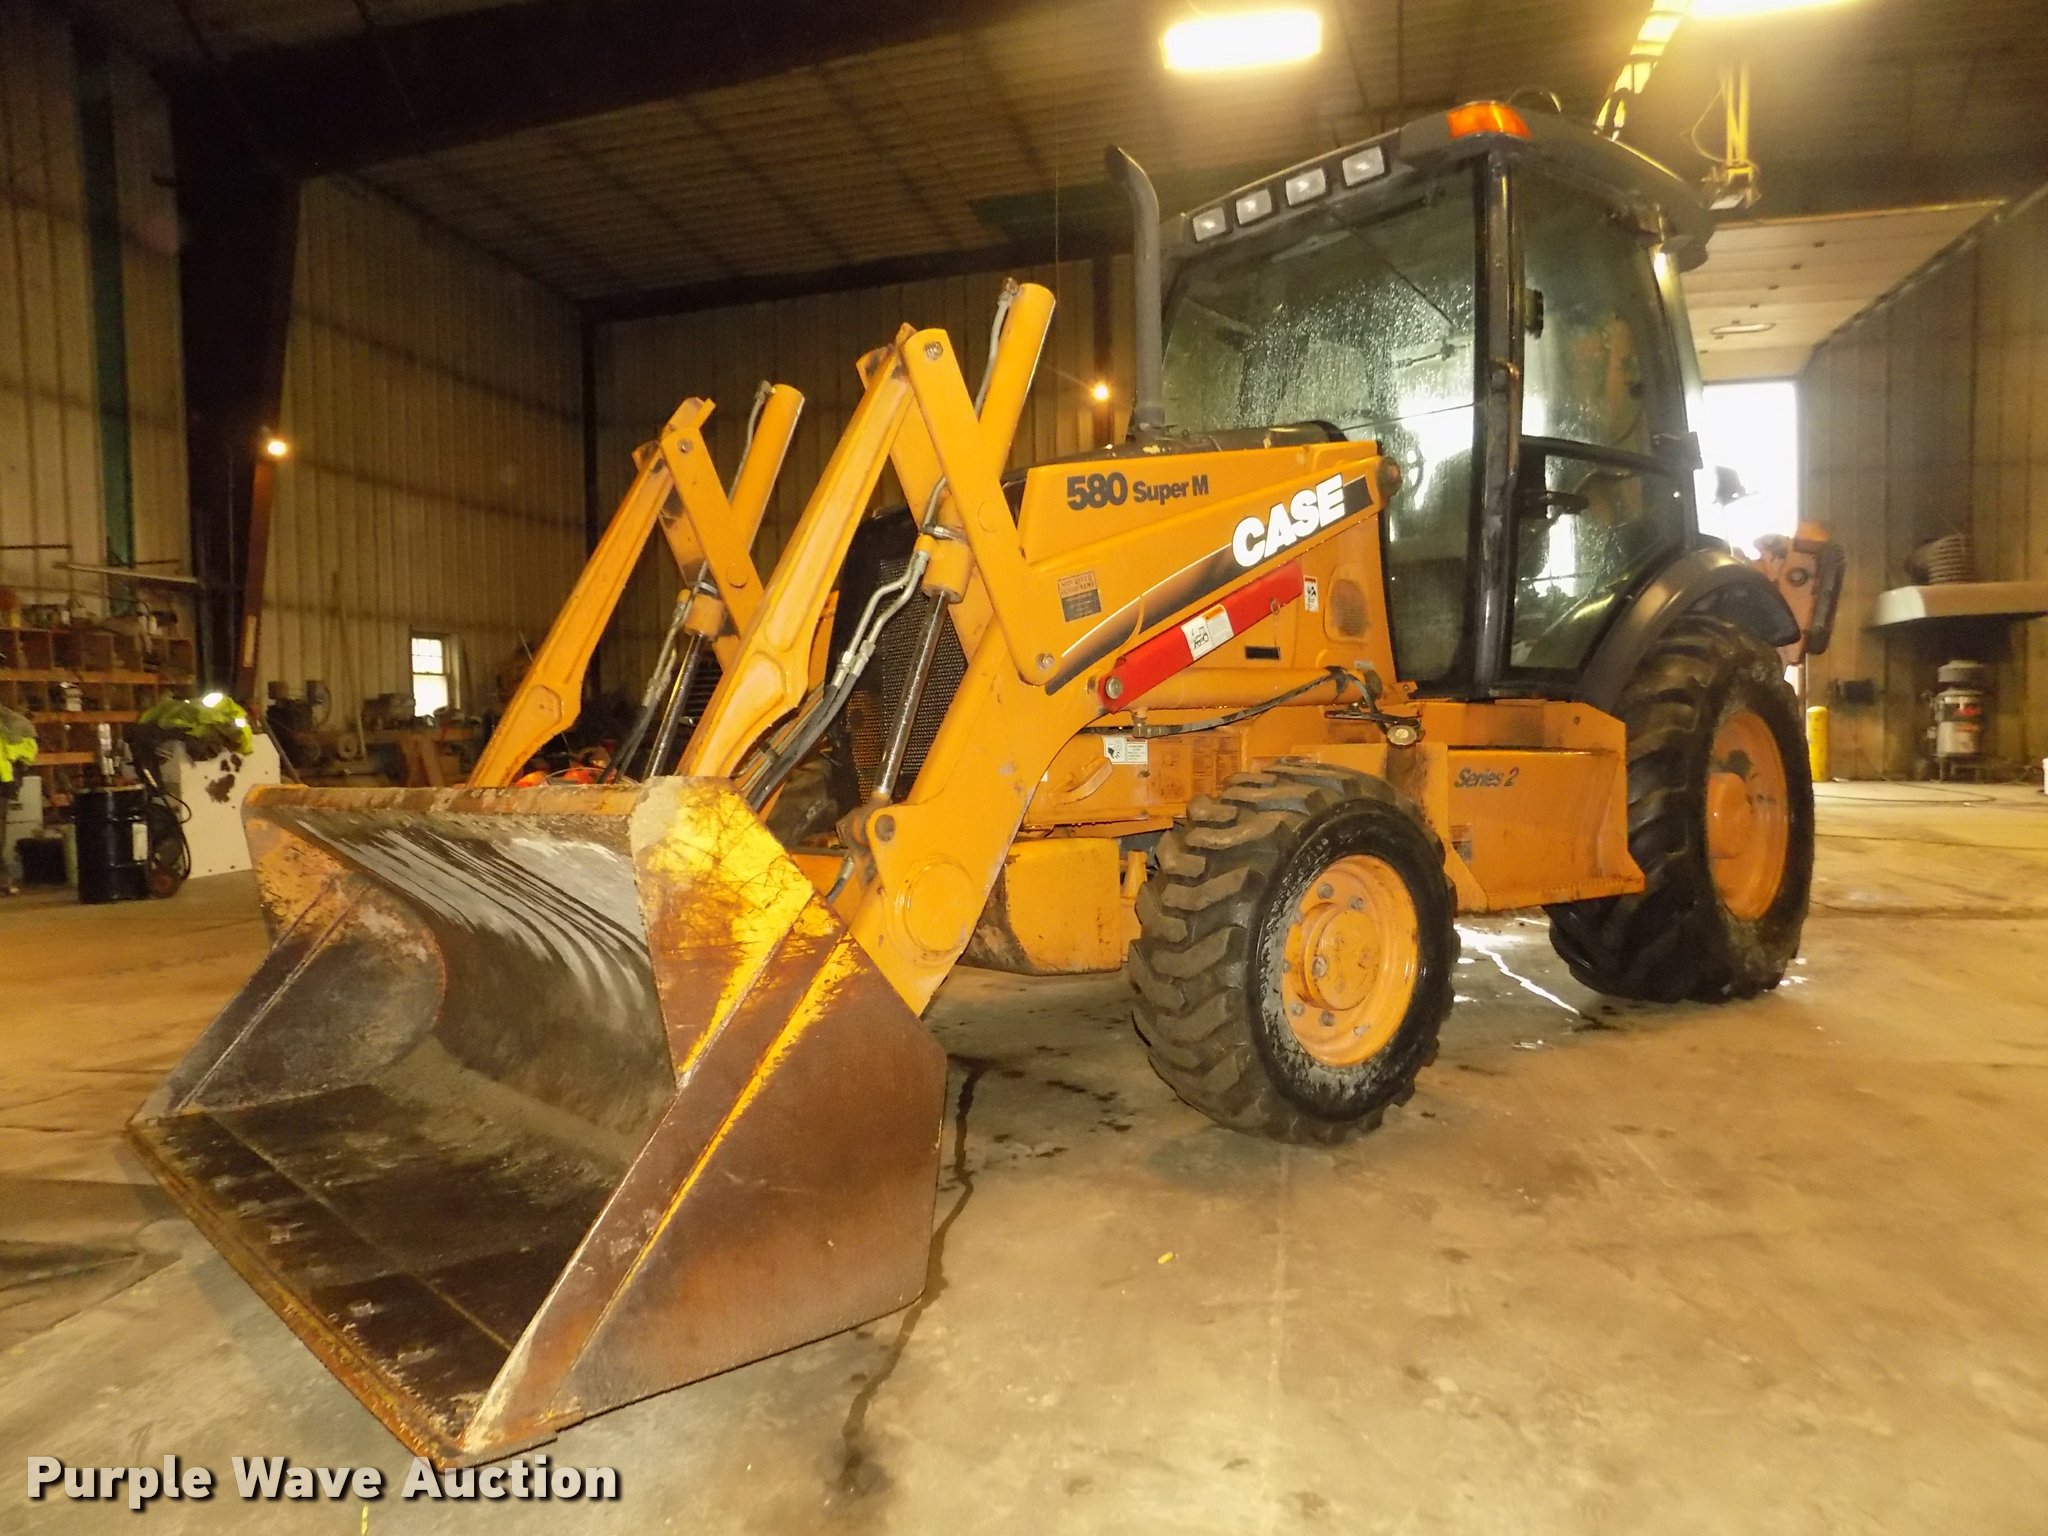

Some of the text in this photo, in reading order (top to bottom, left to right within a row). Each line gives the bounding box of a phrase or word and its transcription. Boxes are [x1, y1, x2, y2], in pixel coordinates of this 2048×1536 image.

[1066, 471, 1209, 510] 580 Super M
[1231, 472, 1346, 568] CASE
[1454, 766, 1520, 788] Series 2
